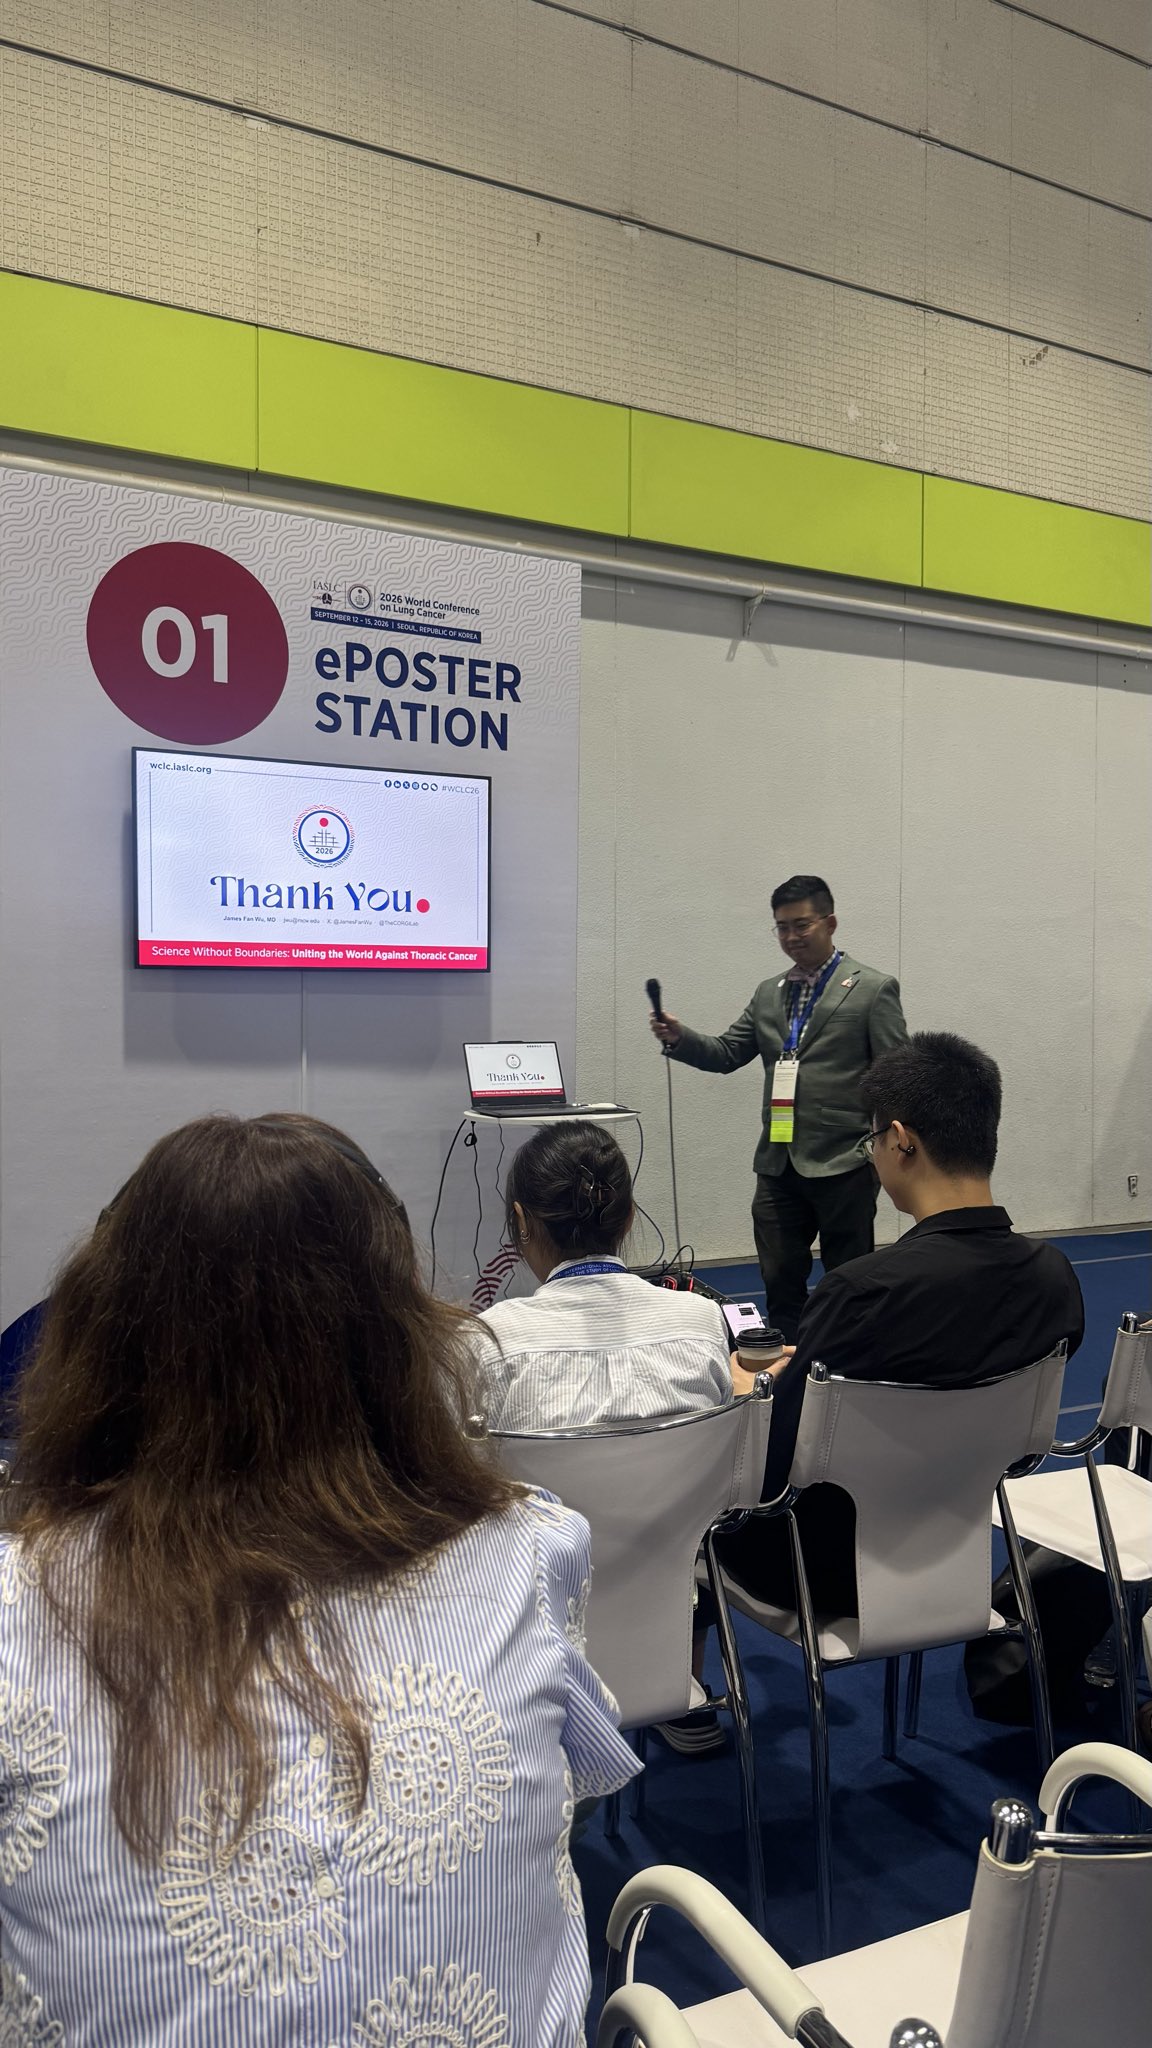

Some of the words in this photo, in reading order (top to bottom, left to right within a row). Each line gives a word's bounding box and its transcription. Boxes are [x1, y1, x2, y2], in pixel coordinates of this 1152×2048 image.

[313, 581, 341, 593] IASLC
[380, 592, 402, 604] 2026
[404, 596, 431, 608] World
[432, 600, 480, 616] Conference
[380, 603, 391, 612] on
[393, 604, 414, 616] Lung
[416, 608, 446, 620] Cancer
[314, 611, 351, 622] SEPTEMBER
[364, 618, 372, 626] 15,
[397, 622, 418, 632] SEOUL,
[419, 626, 448, 636] REPUBLIC
[458, 632, 478, 640] KOREA
[142, 606, 228, 683] 01
[315, 642, 521, 703] ePOSTER
[315, 692, 508, 751] STATION
[150, 762, 212, 774] wclc.iaslc.org
[442, 785, 480, 794] #WCLC26
[315, 847, 334, 855] 2026
[210, 876, 334, 910] Thank
[152, 946, 190, 956] Science
[192, 947, 232, 957] Without
[234, 948, 290, 958] Boundaries:
[292, 949, 326, 960] Uniting
[328, 949, 344, 959] the
[346, 950, 373, 960] World
[375, 950, 408, 961] Against
[410, 952, 446, 961] Thoracic
[448, 952, 478, 961] Cancer
[487, 1072, 520, 1082] Thank
